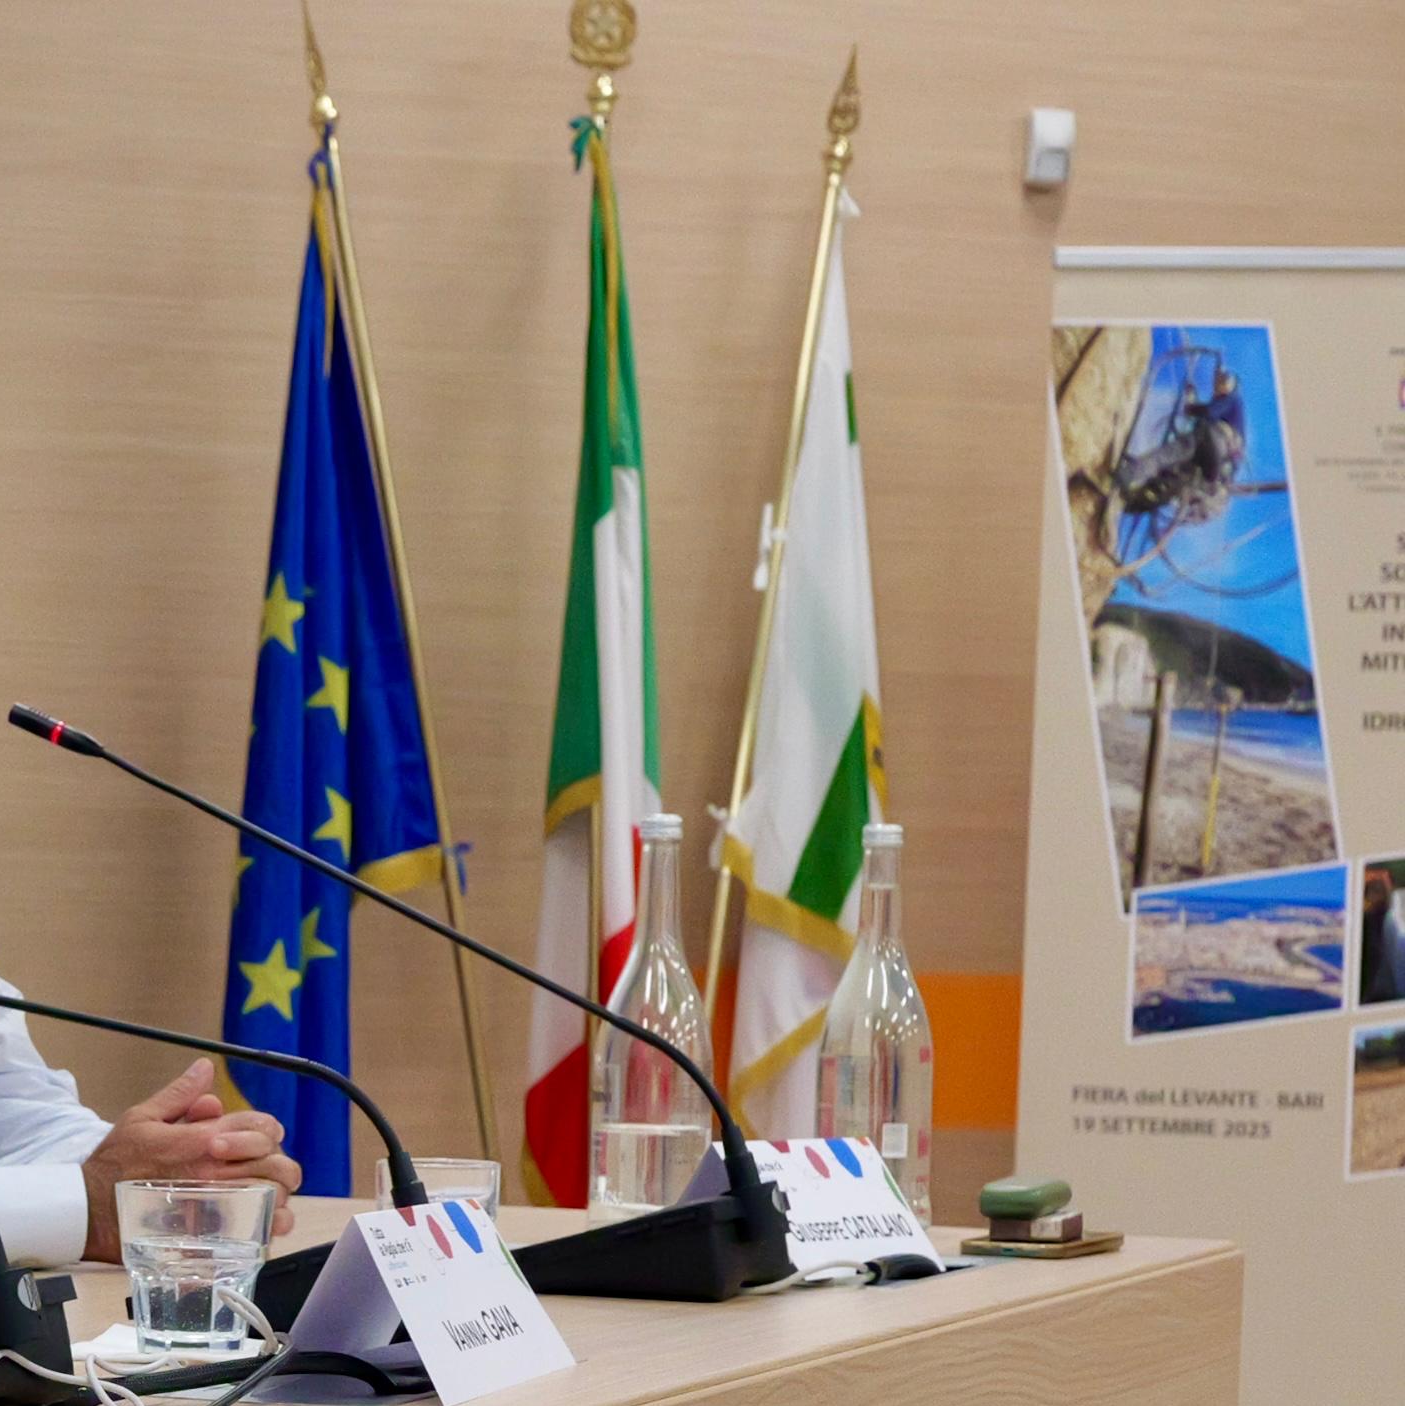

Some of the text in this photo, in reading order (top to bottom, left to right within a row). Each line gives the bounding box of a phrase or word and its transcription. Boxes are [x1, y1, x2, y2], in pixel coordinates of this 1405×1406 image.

[1072, 1085, 1128, 1105] FIERA
[1171, 1088, 1259, 1109] LEVANTE
[1277, 1090, 1325, 1111] BARI
[1072, 1115, 1272, 1139] 19 SETTEMBRE 2025
[842, 1212, 914, 1241] CATALANO
[480, 1304, 525, 1342] GAVA
